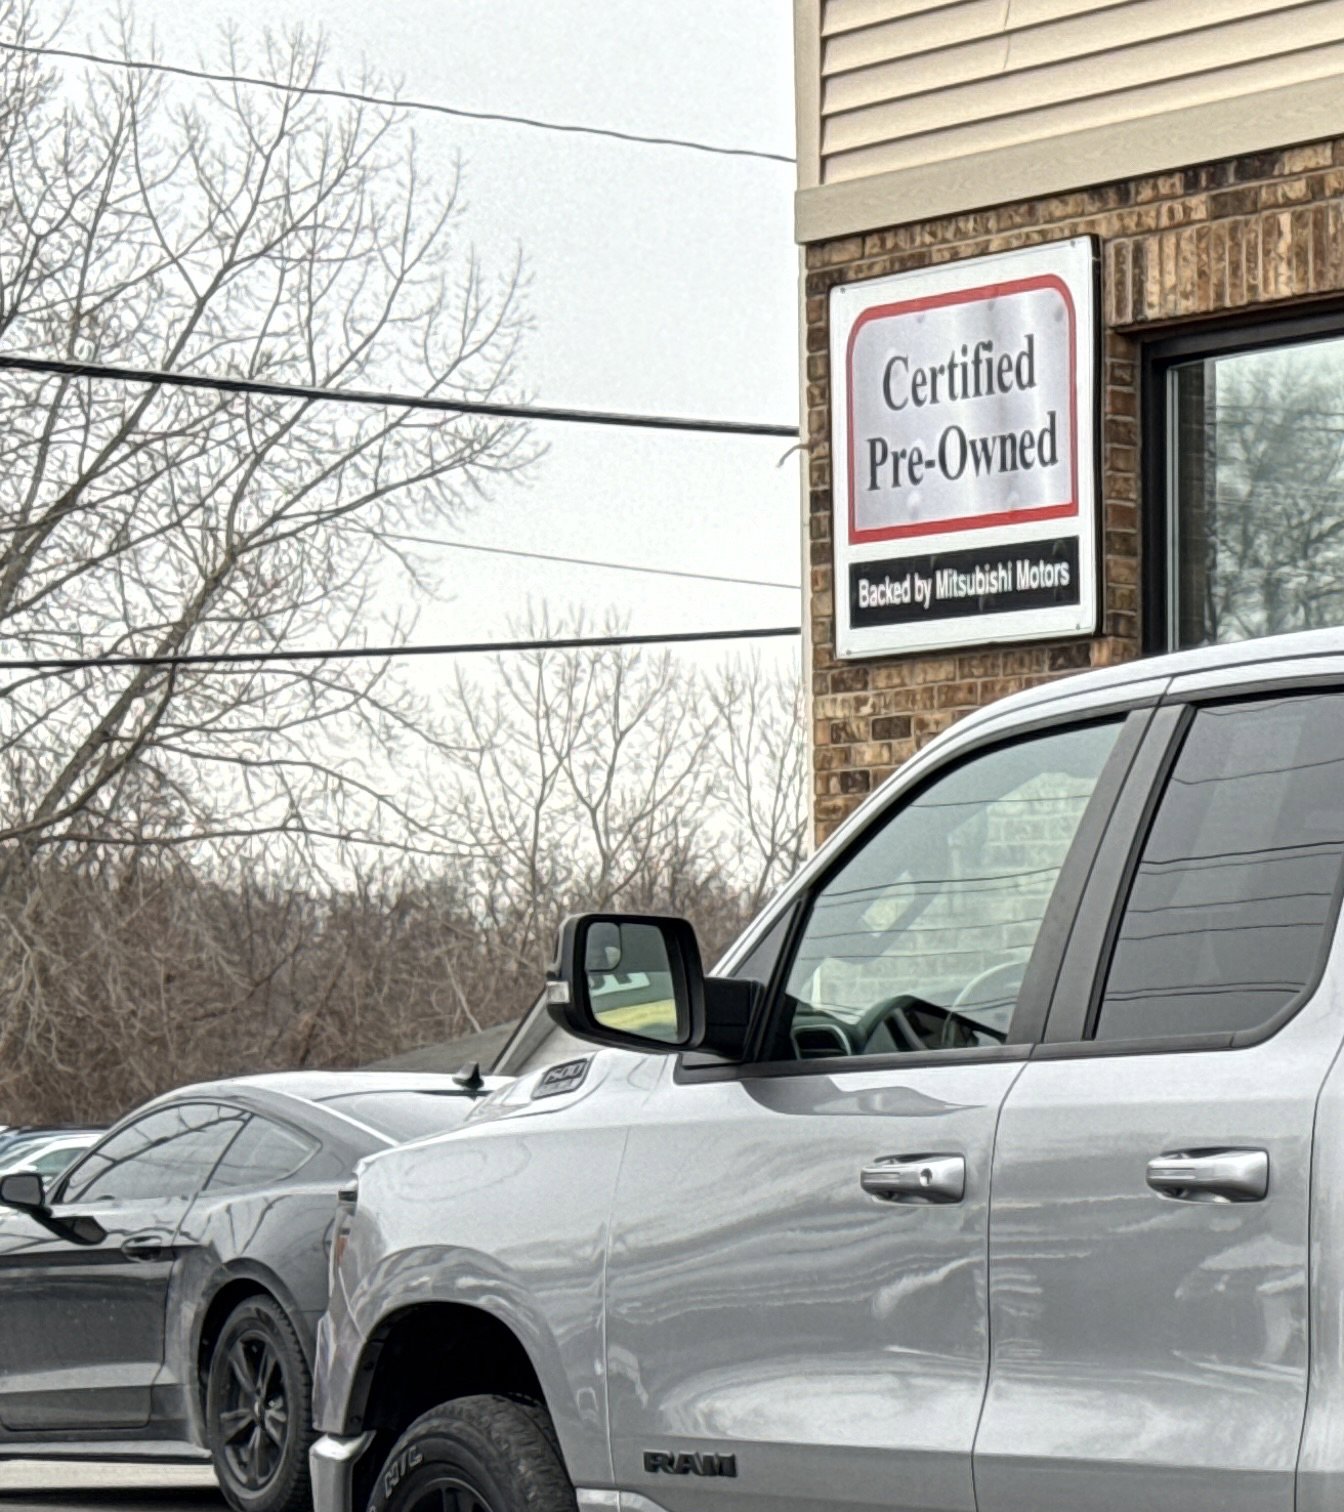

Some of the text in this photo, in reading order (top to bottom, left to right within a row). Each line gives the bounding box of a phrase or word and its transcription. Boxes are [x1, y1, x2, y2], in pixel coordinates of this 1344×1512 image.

[882, 334, 1037, 411] Certified
[865, 410, 1059, 491] Pre-Owned
[858, 559, 1070, 610] Backed by Mitsubishi Motors
[643, 1448, 738, 1478] RAM
